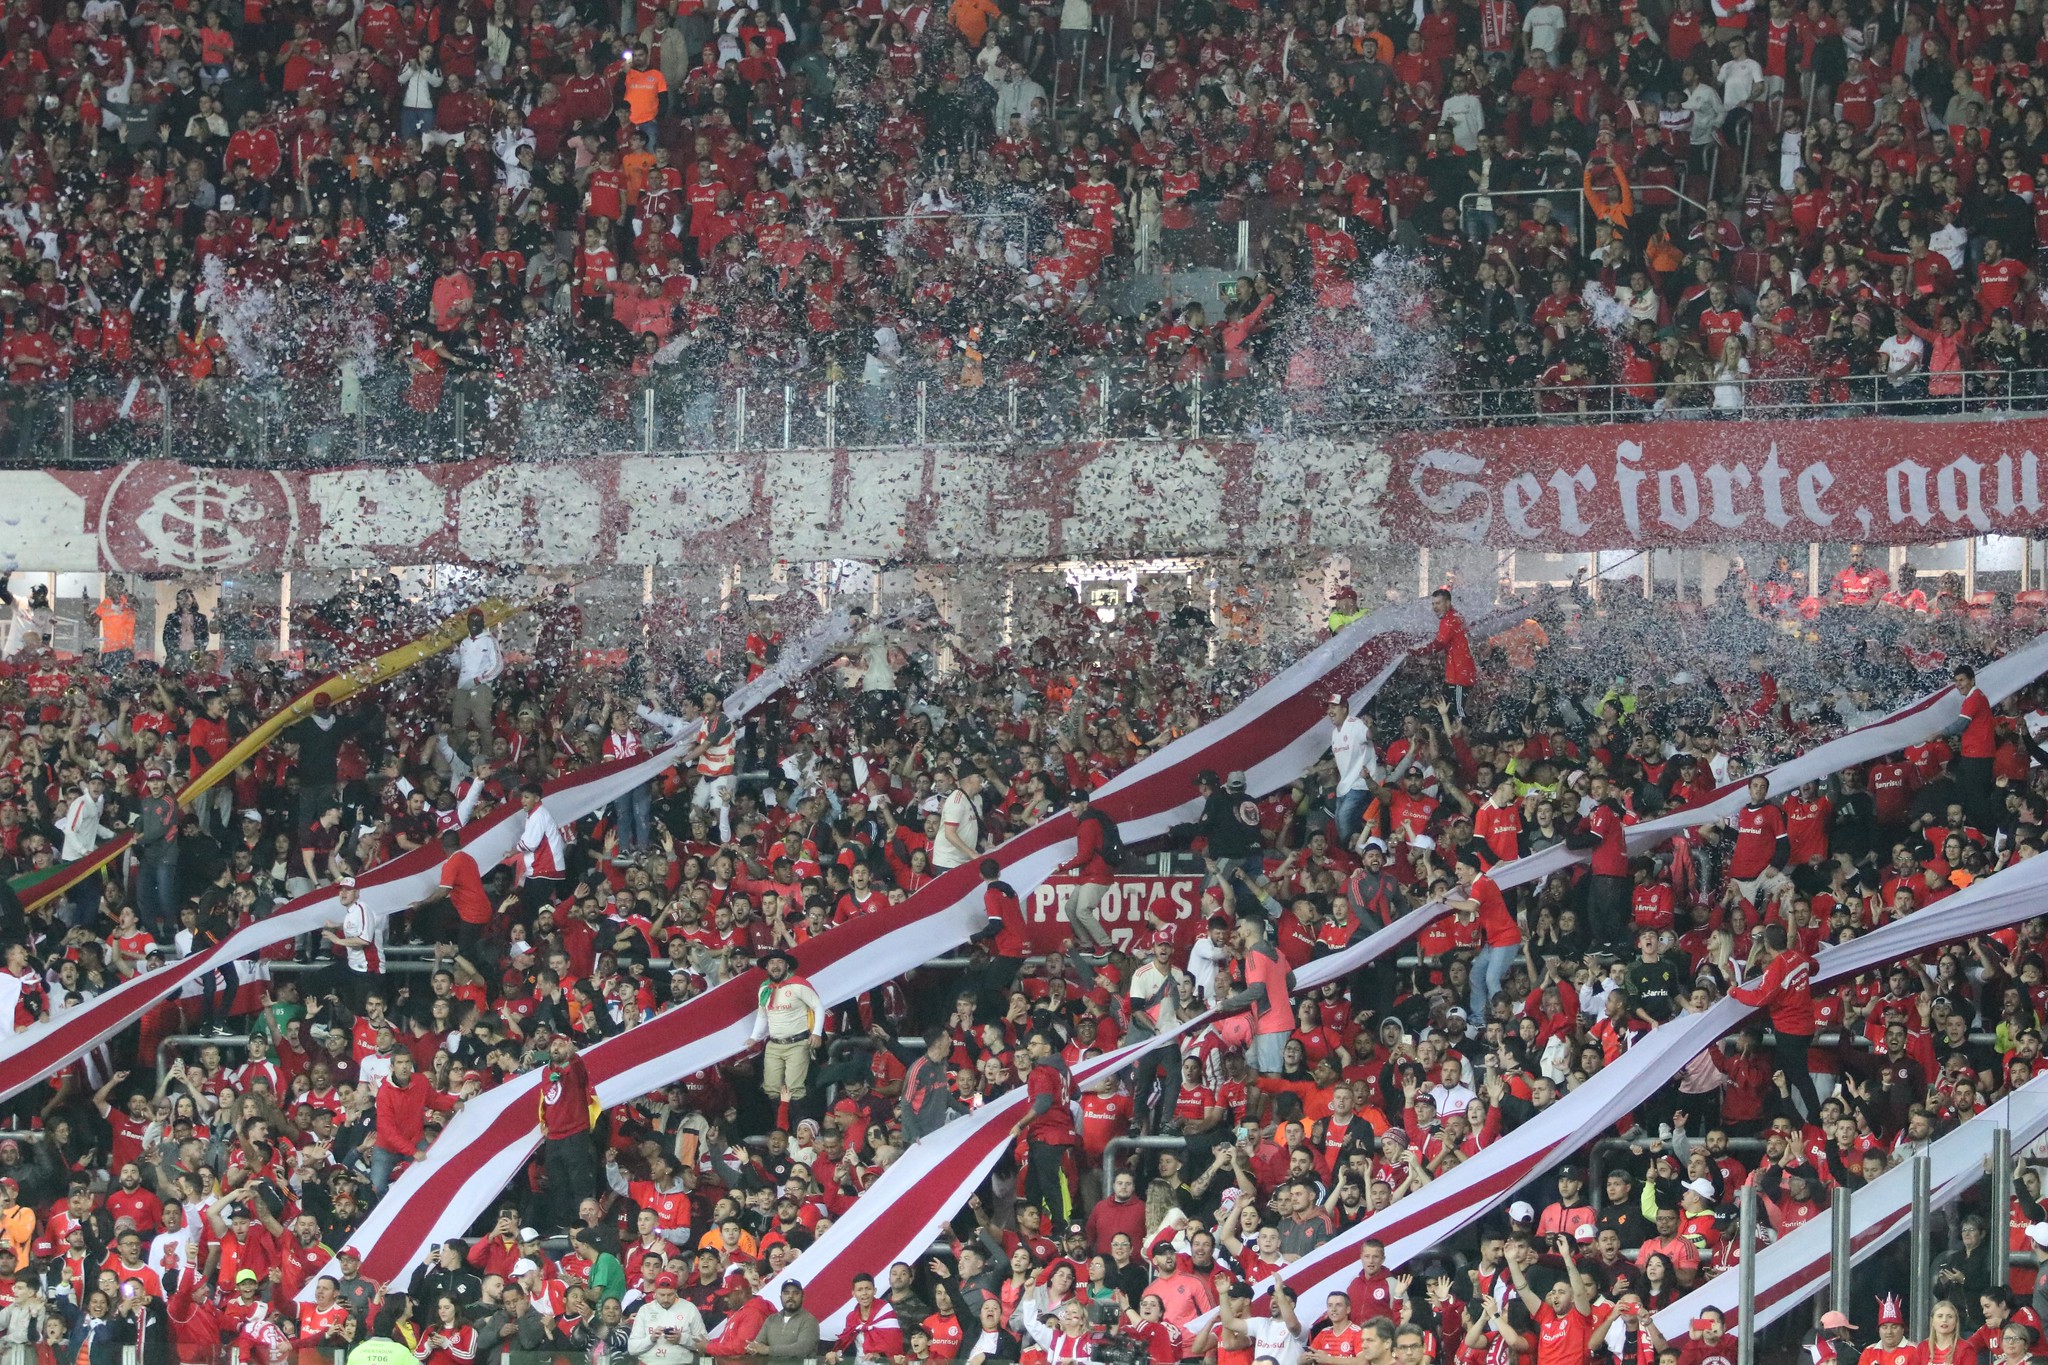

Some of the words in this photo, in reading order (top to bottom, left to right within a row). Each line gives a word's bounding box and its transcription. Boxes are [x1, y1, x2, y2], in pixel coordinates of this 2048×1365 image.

[1411, 448, 1597, 544] Ser
[1614, 439, 1873, 541] forte,
[1875, 779, 1902, 789] Banrisul
[1034, 881, 1193, 923] PEOTAS
[1088, 1111, 1115, 1120] Banrisul
[1989, 1338, 1997, 1349] 10
[656, 1348, 667, 1358] 24
